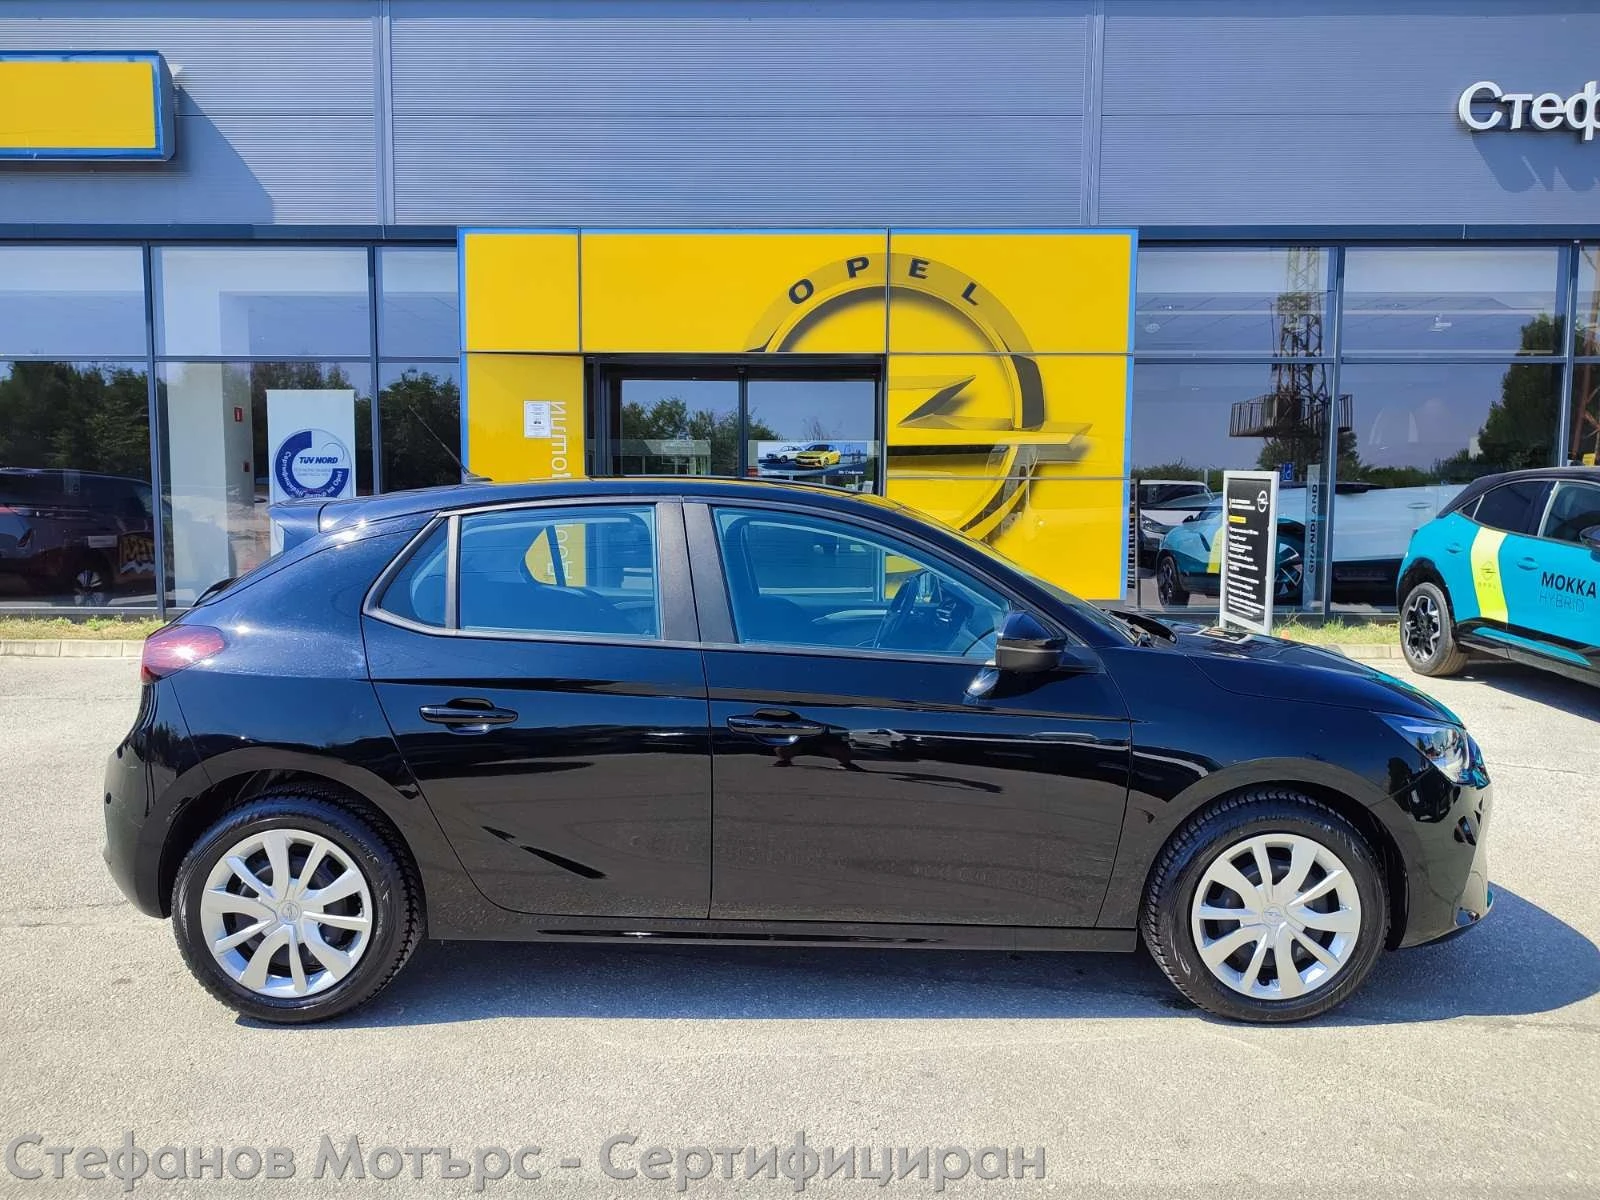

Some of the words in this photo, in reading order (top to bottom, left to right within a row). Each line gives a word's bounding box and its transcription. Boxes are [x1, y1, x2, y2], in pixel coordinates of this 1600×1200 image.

[788, 256, 982, 306] OPEL
[551, 401, 572, 478] ошли
[315, 456, 339, 464] NORD
[1541, 571, 1596, 599] MOKKA
[1539, 591, 1585, 612] HYBRID
